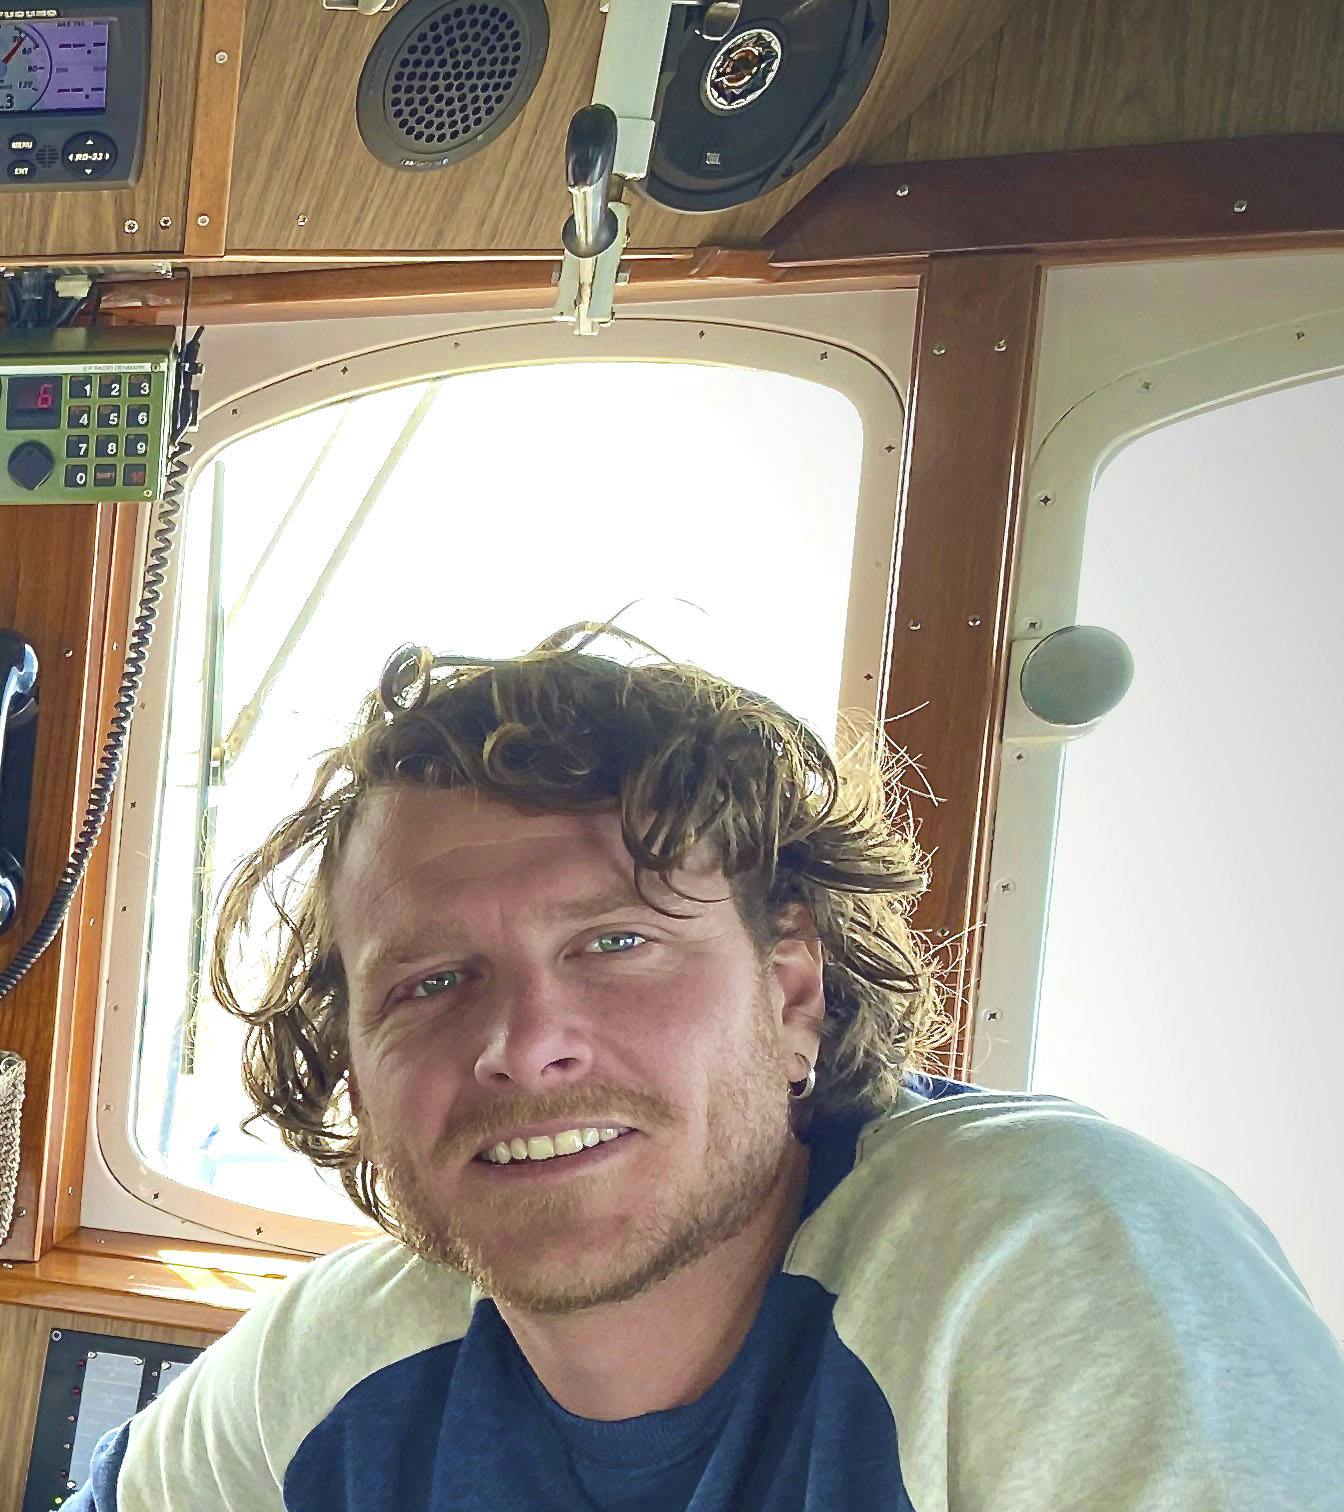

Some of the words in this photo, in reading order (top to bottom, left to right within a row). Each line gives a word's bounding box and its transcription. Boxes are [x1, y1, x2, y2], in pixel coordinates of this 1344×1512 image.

[84, 385, 92, 397] 1
[111, 383, 119, 396] 2
[140, 382, 150, 395] 3
[38, 383, 53, 409] 6
[79, 413, 88, 426] 4
[109, 412, 118, 425] 5
[137, 412, 147, 424] 6
[79, 443, 87, 456] 7
[107, 442, 116, 455] 8
[137, 441, 146, 454] 9
[76, 472, 86, 484] 0
